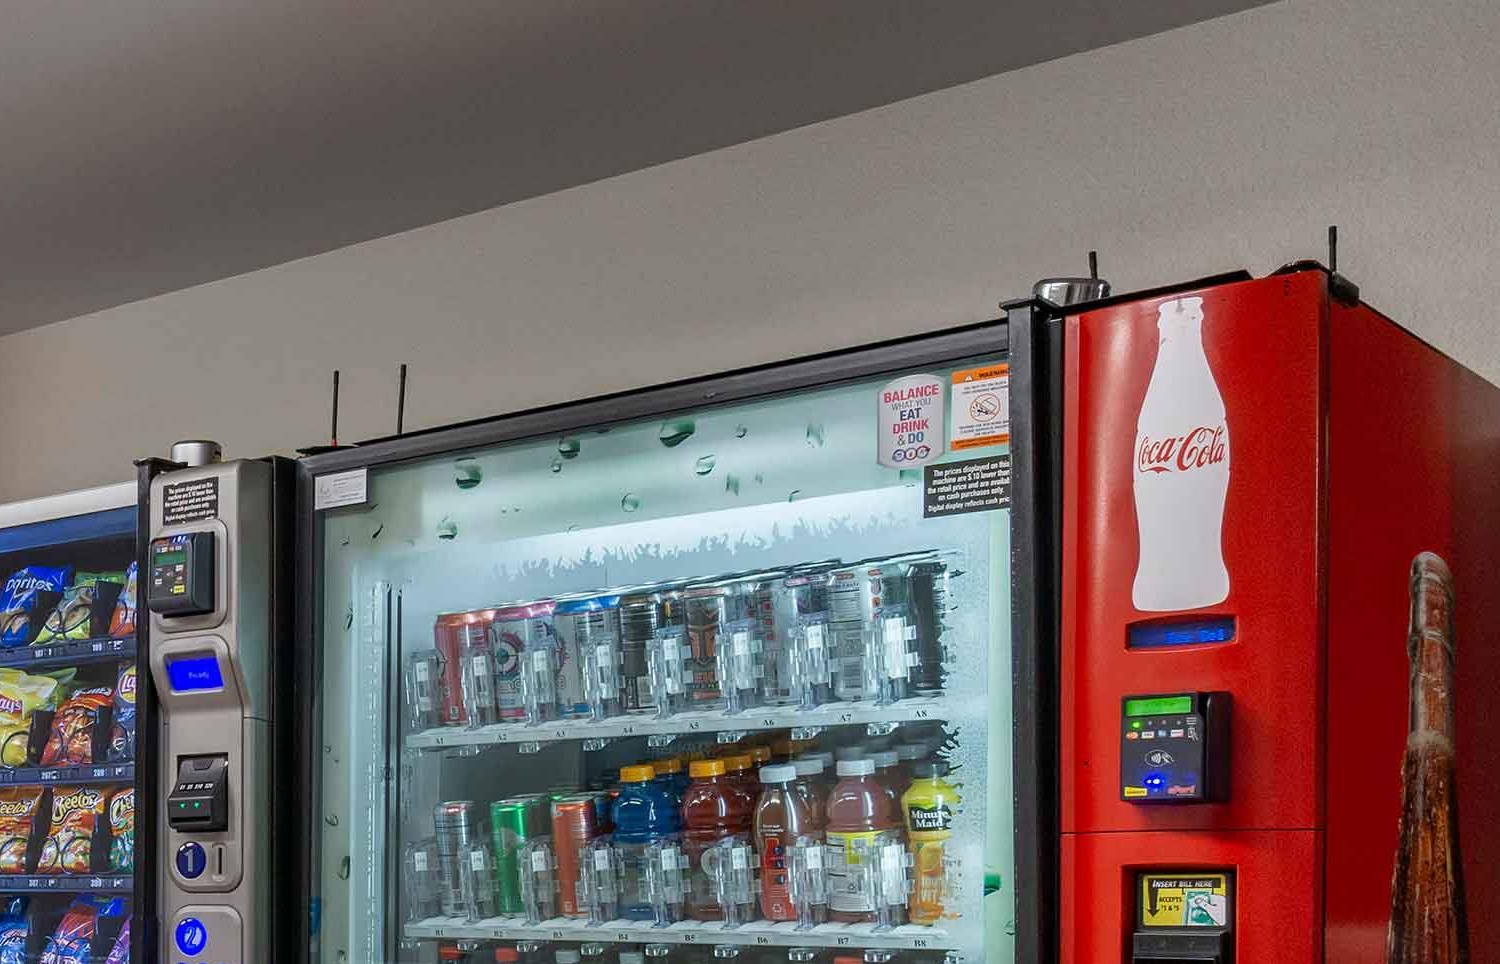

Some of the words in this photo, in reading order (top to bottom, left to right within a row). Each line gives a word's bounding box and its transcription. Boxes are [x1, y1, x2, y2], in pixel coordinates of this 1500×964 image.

[883, 384, 939, 403] BALANCE
[891, 400, 915, 411] WHAT
[915, 397, 931, 407] YOU
[900, 407, 921, 421] EAT
[892, 418, 929, 434] DRINK
[897, 434, 905, 446] &
[908, 431, 924, 444] DO
[1138, 425, 1225, 473] Coca-Cola
[933, 469, 943, 477] The
[945, 467, 962, 479] prices
[963, 461, 989, 473] displayed
[932, 477, 956, 486] machine
[937, 485, 952, 493] retail
[968, 481, 979, 489] and
[961, 489, 989, 498] purchases
[4, 578, 54, 593] Doritos
[841, 713, 852, 722] A7
[914, 709, 927, 718] A8
[763, 718, 774, 727] A6
[622, 727, 633, 735] A4
[51, 792, 100, 825] Cheetos
[911, 807, 950, 821] Minute
[915, 818, 943, 828] Maid
[184, 848, 193, 872] 1
[1152, 879, 1177, 889] INSERT
[1178, 879, 1192, 888] BILL
[1194, 879, 1213, 889] HERE
[1159, 896, 1182, 904] ACCEPTS
[685, 934, 695, 942] B5
[757, 936, 769, 944] B6
[837, 937, 849, 945] B7
[914, 939, 926, 947] B8
